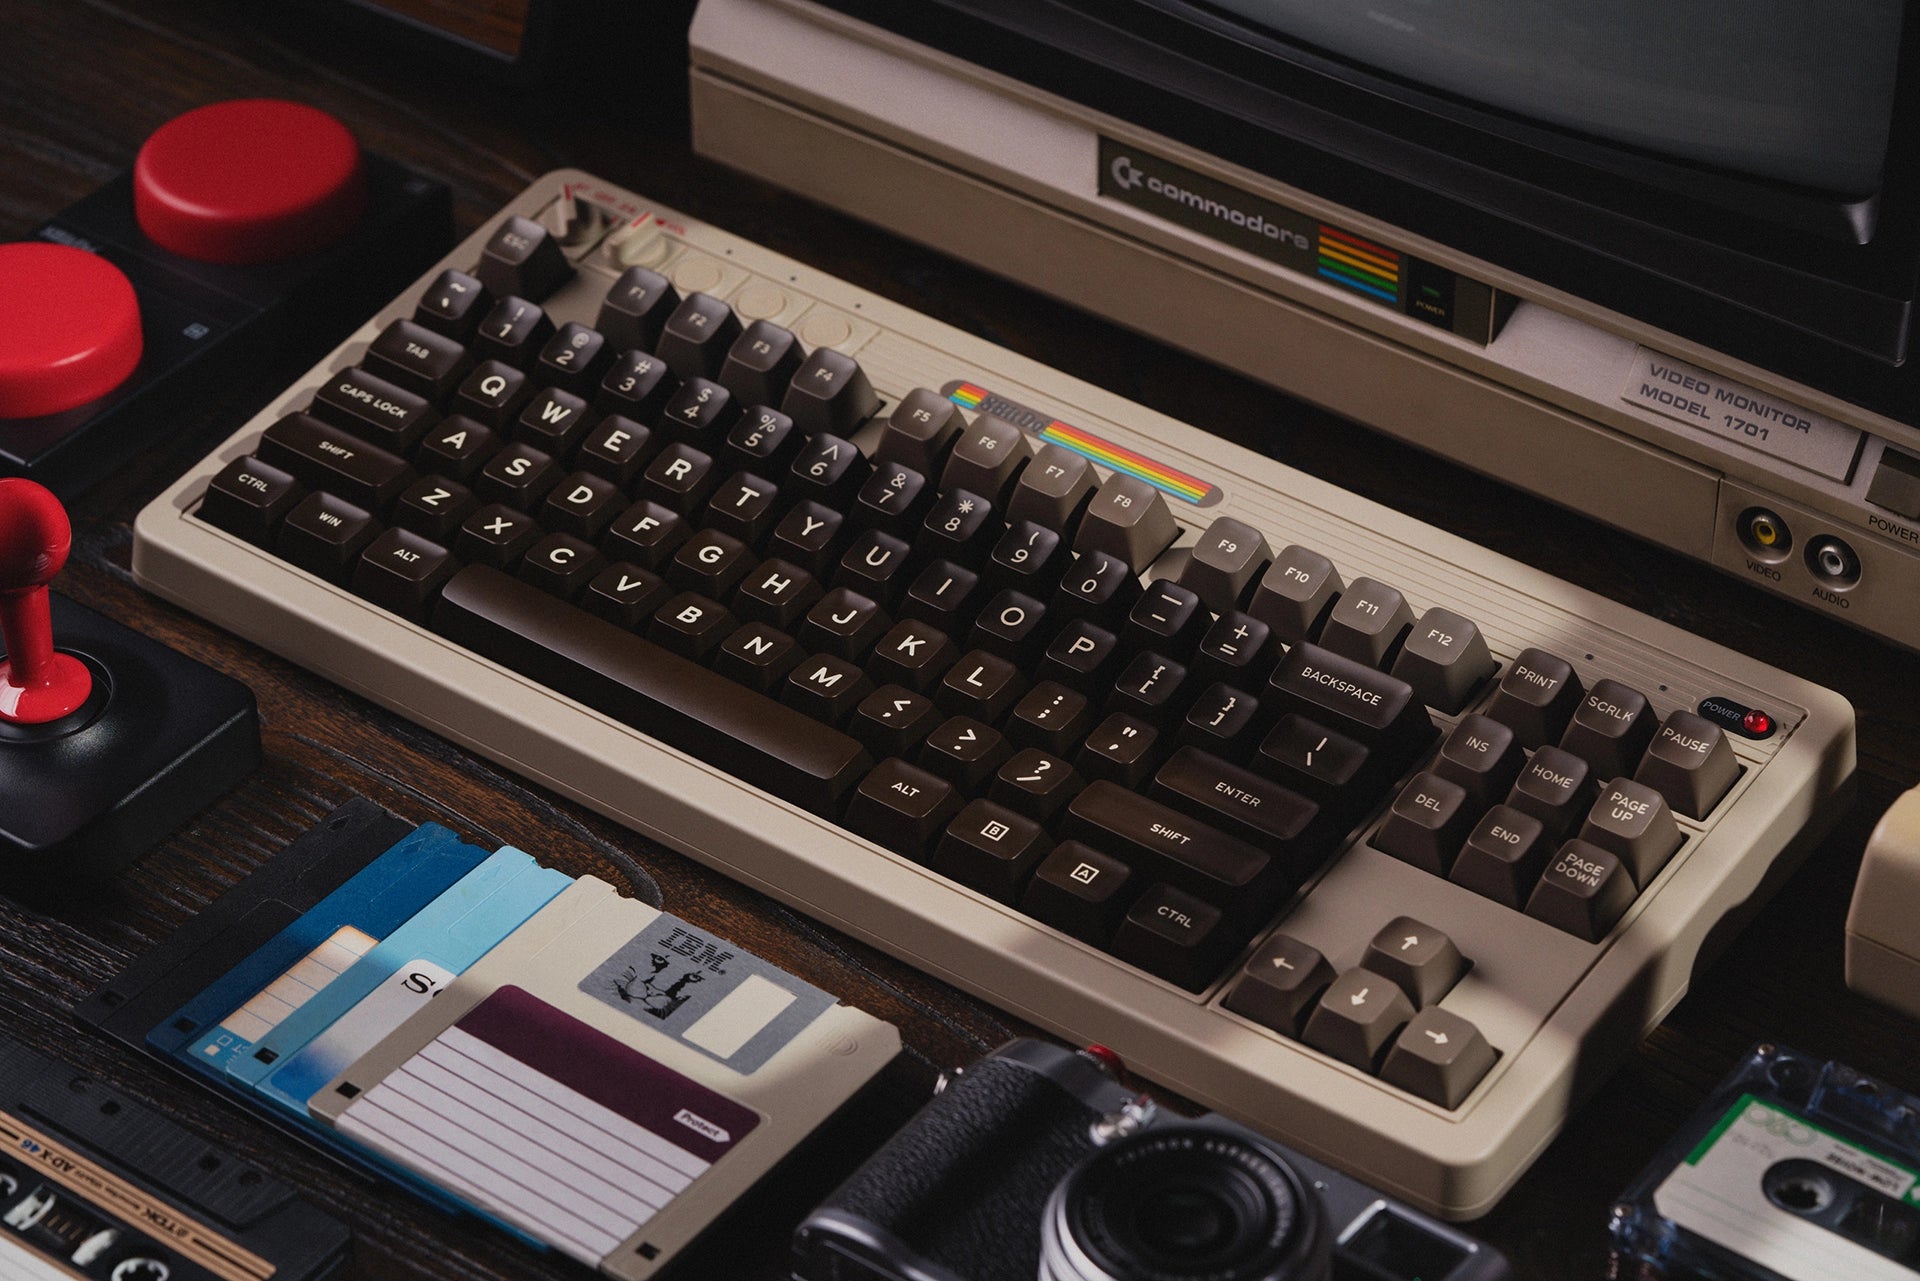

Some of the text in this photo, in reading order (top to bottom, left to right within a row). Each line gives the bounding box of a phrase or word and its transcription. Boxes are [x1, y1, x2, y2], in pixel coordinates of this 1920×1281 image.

[1147, 176, 1309, 250] commodore
[502, 231, 529, 251] ESC
[628, 285, 646, 300] F1
[688, 312, 708, 327] F2
[499, 323, 513, 338] 1
[405, 341, 430, 359] TAB
[555, 349, 575, 365] 2
[752, 340, 771, 355] F3
[815, 368, 834, 382] F4
[480, 375, 506, 397] Q
[619, 378, 634, 392] 3
[339, 383, 408, 419] CAPS LOCK
[1650, 364, 1812, 434] VIDEO MONITOR
[541, 401, 571, 425] W
[683, 405, 698, 419] 4
[912, 408, 932, 423] F5
[1640, 383, 1770, 440] MODEL 1701
[441, 431, 467, 450] A
[603, 430, 631, 452] E
[744, 432, 763, 447] 5
[978, 435, 998, 450] F6
[318, 441, 355, 460] SHIFT
[504, 458, 532, 476] S
[664, 458, 692, 481] R
[810, 461, 828, 476] 6
[1045, 464, 1065, 479] F7
[237, 472, 268, 493] CTRL
[421, 487, 451, 506] Z
[567, 485, 594, 504] D
[736, 486, 761, 507] T
[879, 488, 895, 504] 7
[1113, 494, 1132, 508] F8
[318, 511, 343, 527] WIN
[483, 516, 513, 535] X
[631, 516, 661, 532] F
[801, 516, 825, 536] Y
[944, 517, 961, 532] 8
[1869, 514, 1919, 544] POWER
[393, 548, 421, 563] ALT
[698, 545, 724, 564] G
[1010, 548, 1029, 563] 9
[1217, 539, 1237, 553] F9
[549, 548, 575, 564] C
[865, 545, 891, 567] U
[1284, 566, 1310, 583] F10
[1746, 559, 1781, 582] VIDEO
[616, 575, 642, 592] V
[761, 573, 792, 595] H
[935, 578, 953, 596] I
[1355, 599, 1379, 616] F11
[1812, 587, 1850, 609] AUDIO
[676, 605, 703, 624] B
[831, 609, 858, 624] J
[1000, 606, 1025, 626] O
[743, 636, 774, 656] N
[896, 634, 926, 657] K
[1068, 636, 1096, 654] P
[1427, 629, 1453, 647] F12
[809, 666, 843, 688] M
[966, 666, 984, 687] L
[1301, 666, 1382, 706] BACKSPACE
[1515, 665, 1559, 690] PRINT
[1588, 696, 1635, 723] SCRLK
[1702, 700, 1741, 721] POWER
[1465, 736, 1490, 753] INS
[1662, 727, 1709, 753] PAUSE
[1532, 764, 1573, 788] HOME
[891, 782, 920, 797] ALT
[1214, 781, 1261, 807] ENTER
[1414, 793, 1441, 812] DEL
[1610, 792, 1649, 814] PAGE
[1612, 808, 1634, 821] UP
[1149, 823, 1191, 845] SHIFT
[1490, 825, 1521, 844] END
[1565, 853, 1604, 876] PAGE
[1555, 862, 1599, 887] DOWN
[1157, 905, 1191, 929] CTRL
[658, 927, 734, 973] IBM
[681, 1111, 720, 1138] Protect
[20, 1138, 41, 1153] 46
